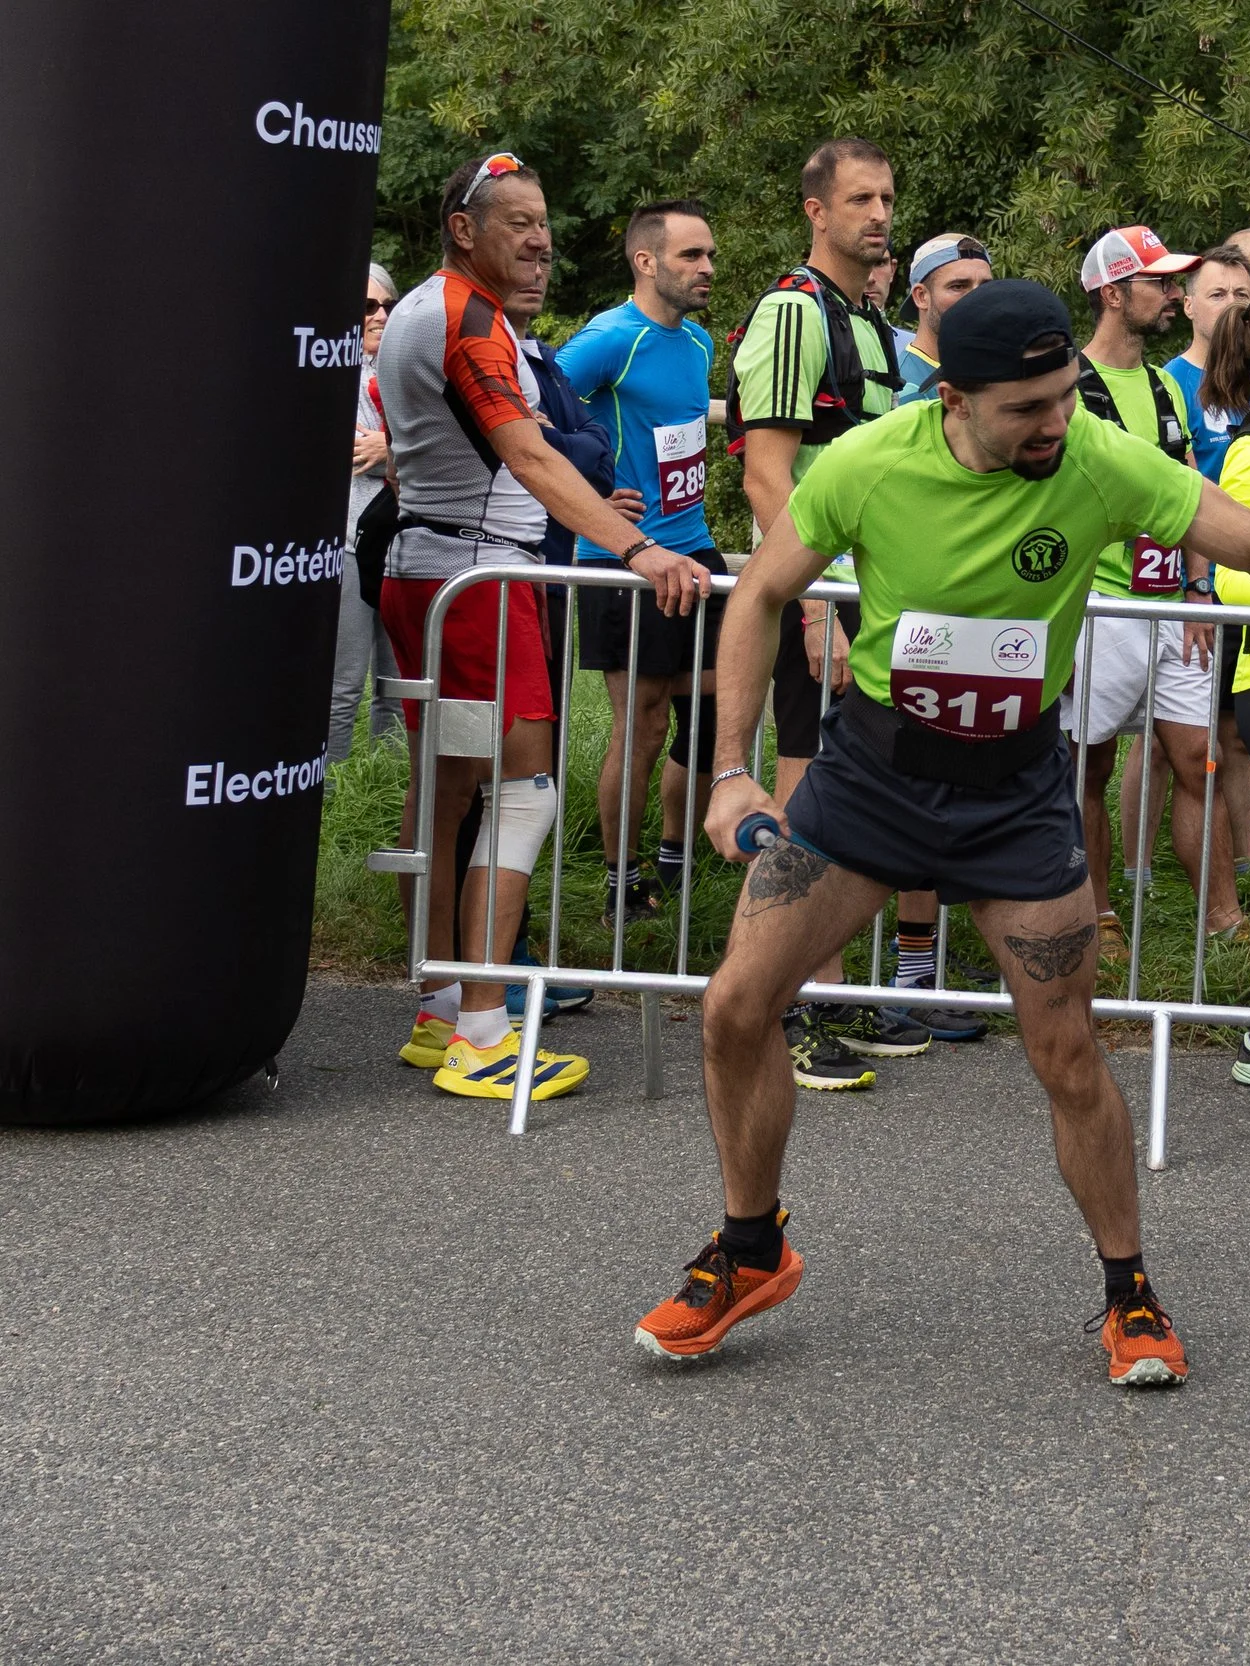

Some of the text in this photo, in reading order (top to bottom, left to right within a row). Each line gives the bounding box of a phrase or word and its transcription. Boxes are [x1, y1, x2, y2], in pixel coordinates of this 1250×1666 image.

[666, 460, 705, 501] 289
[231, 536, 345, 587] Diététiq
[902, 686, 1022, 731] 311
[448, 1056, 459, 1067] 25
